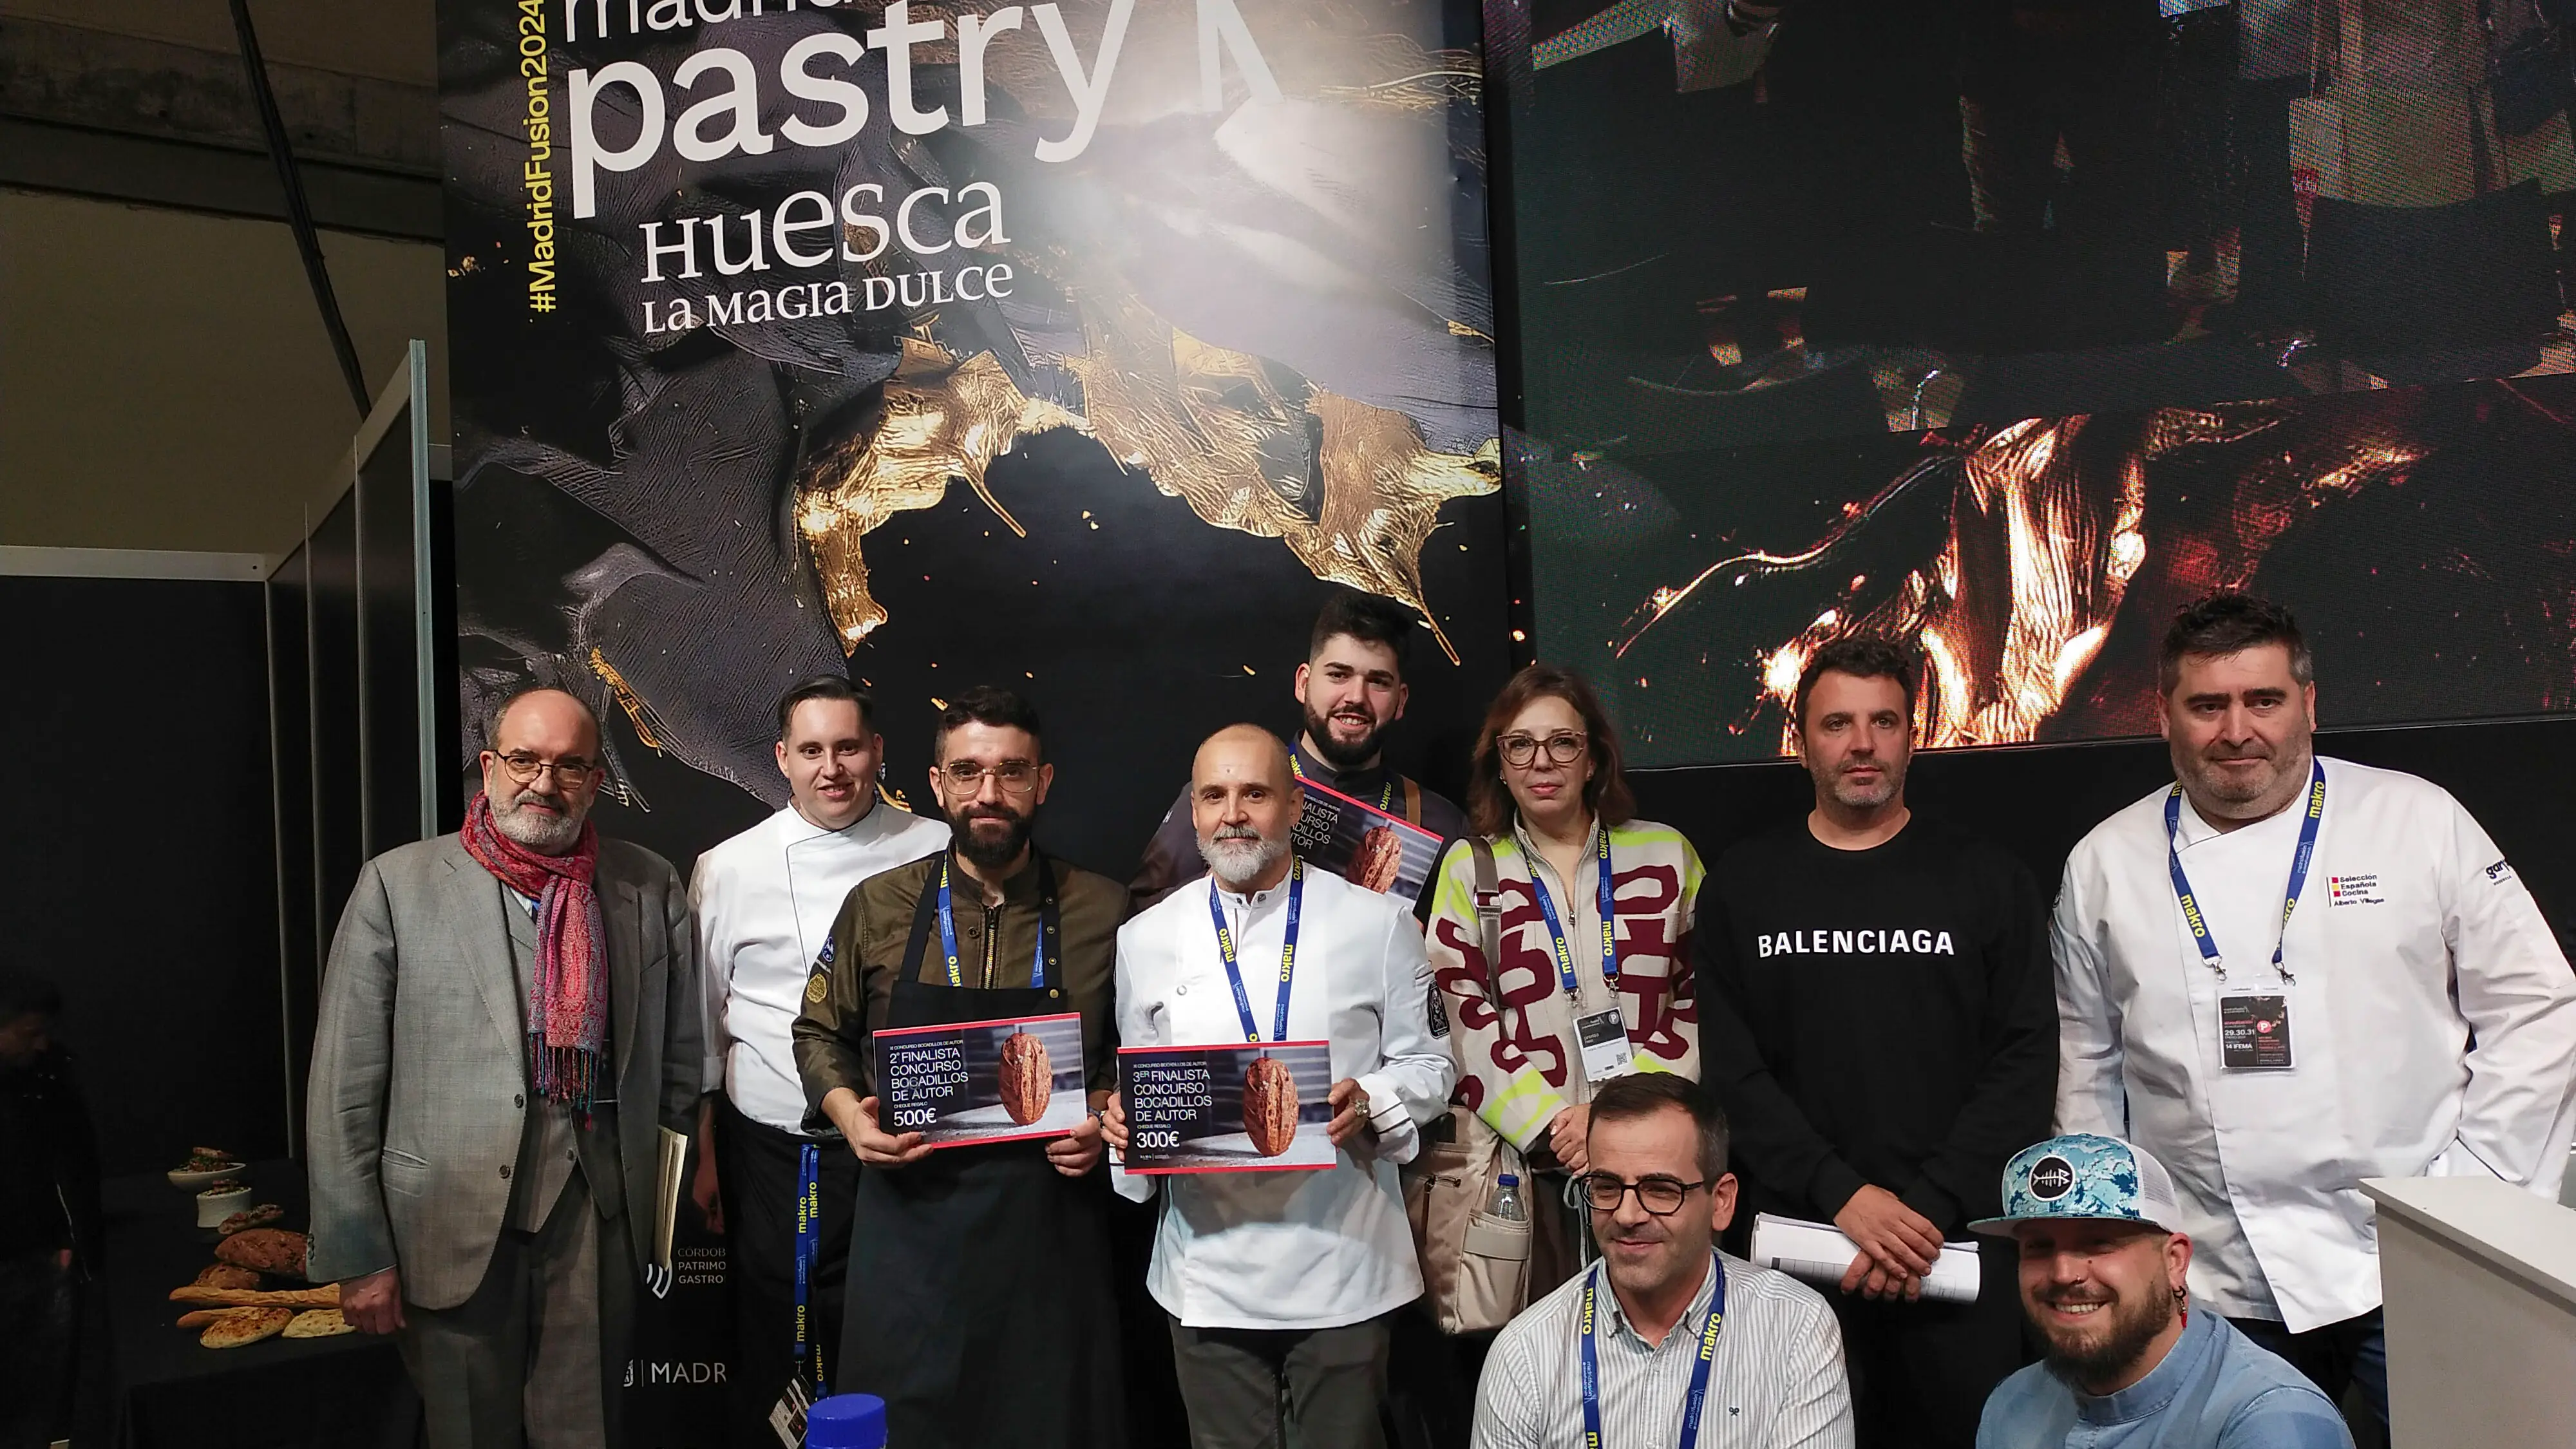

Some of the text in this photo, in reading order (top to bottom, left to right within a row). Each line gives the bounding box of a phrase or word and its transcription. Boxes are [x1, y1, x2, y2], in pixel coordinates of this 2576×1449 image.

[567, 0, 1135, 220] pastry
[518, 0, 557, 313] #MadridFusion2024
[638, 181, 1011, 283] Huesca
[1379, 782, 1392, 811] makro
[2308, 781, 2325, 819] makro
[1600, 829, 1609, 859] makro
[2340, 873, 2377, 883] Selección
[2340, 882, 2376, 890] Española
[2180, 895, 2206, 938] makro
[1218, 928, 1235, 963] makro
[1603, 920, 1612, 956] makro
[1757, 929, 1955, 958] BALENCIAGA
[1280, 944, 1293, 982] makro
[1555, 937, 1572, 974] makro
[890, 1059, 961, 1076] CONCURSO
[902, 1047, 960, 1063] FINALISTA
[891, 1072, 969, 1089] BOCADILLOS
[1133, 1069, 1211, 1082] 3ER FINALISTA
[1133, 1082, 1205, 1095] CONCURSO
[892, 1086, 953, 1101] DE AUTOR
[1135, 1095, 1213, 1108] BOCADILLOS
[893, 1107, 937, 1126] 500€
[1135, 1109, 1197, 1122] DE AUTOR
[1137, 1130, 1180, 1148] 300€
[808, 1182, 818, 1218] makro
[797, 1197, 807, 1234] makro
[678, 1261, 726, 1271] PATRIMO
[678, 1274, 726, 1283] GASTRO
[795, 1305, 805, 1341] makro
[1582, 1287, 1594, 1334] makro
[1700, 1312, 1722, 1361] makro
[651, 1362, 727, 1383] MADR
